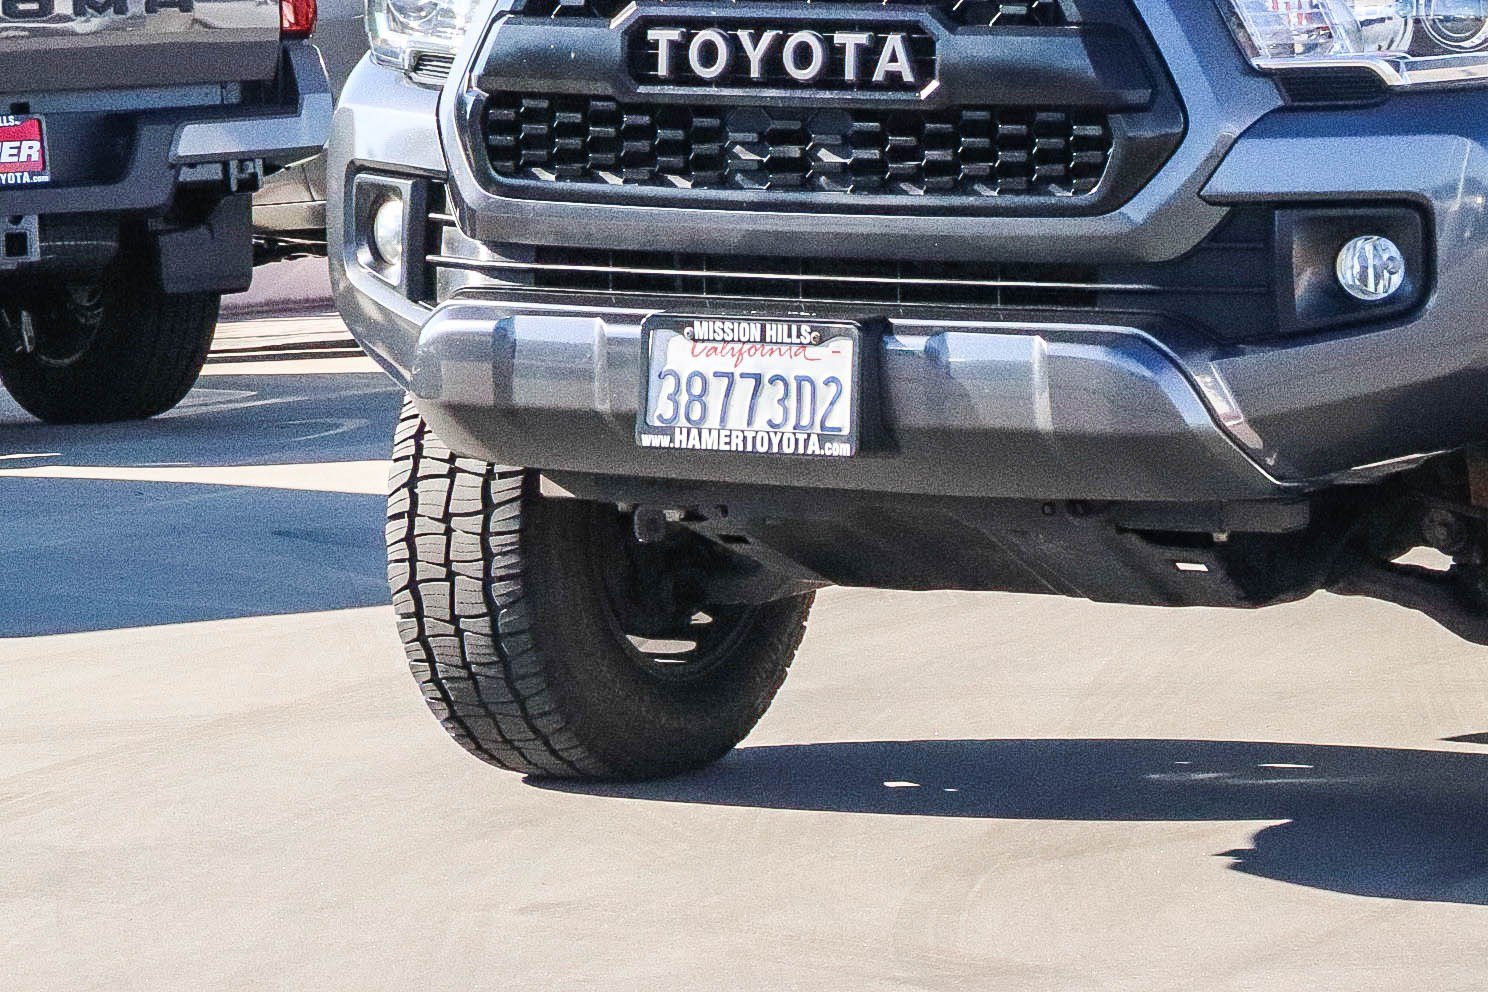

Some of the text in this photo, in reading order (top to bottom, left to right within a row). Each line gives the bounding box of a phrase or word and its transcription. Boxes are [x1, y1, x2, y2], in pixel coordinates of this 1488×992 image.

[647, 27, 915, 83] TOYOTA
[0, 140, 41, 162] ER
[693, 320, 811, 344] MISSION HILLS
[690, 341, 822, 369] California
[655, 368, 843, 433] 38773D2
[641, 426, 851, 457] www.HAMERTOYOTA.com
